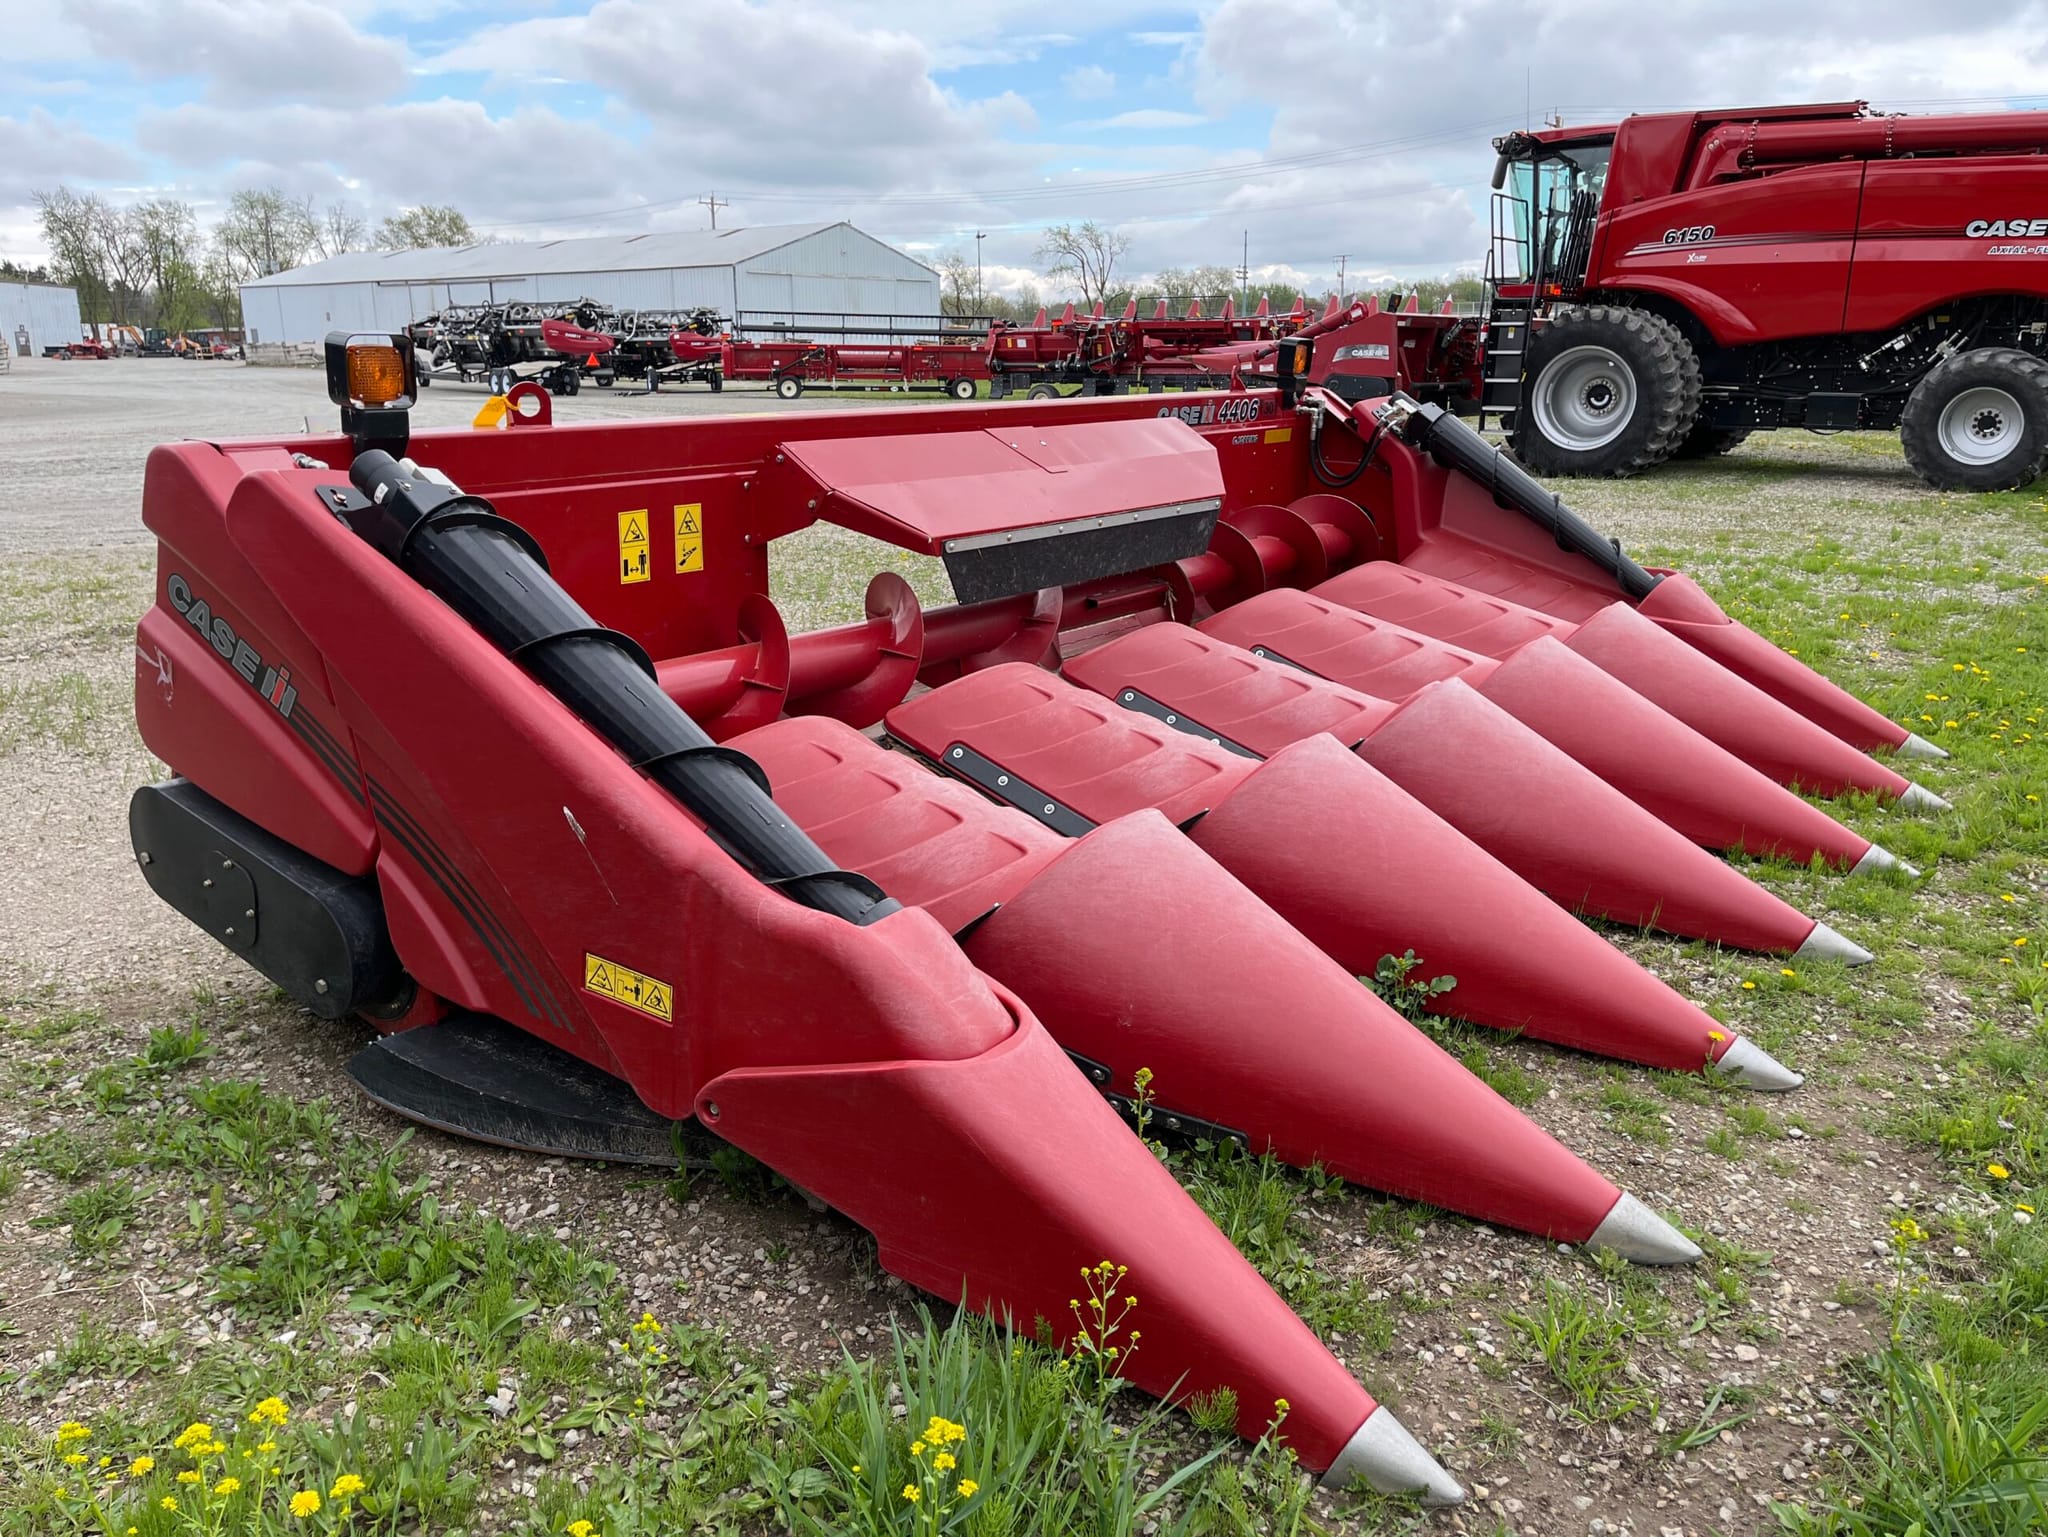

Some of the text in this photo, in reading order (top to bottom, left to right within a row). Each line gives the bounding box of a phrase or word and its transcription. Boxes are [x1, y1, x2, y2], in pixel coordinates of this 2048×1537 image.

[1663, 225, 1715, 244] 6150
[1966, 219, 2048, 238] CASE
[1218, 398, 1260, 424] 4406
[168, 574, 261, 683] CASE
